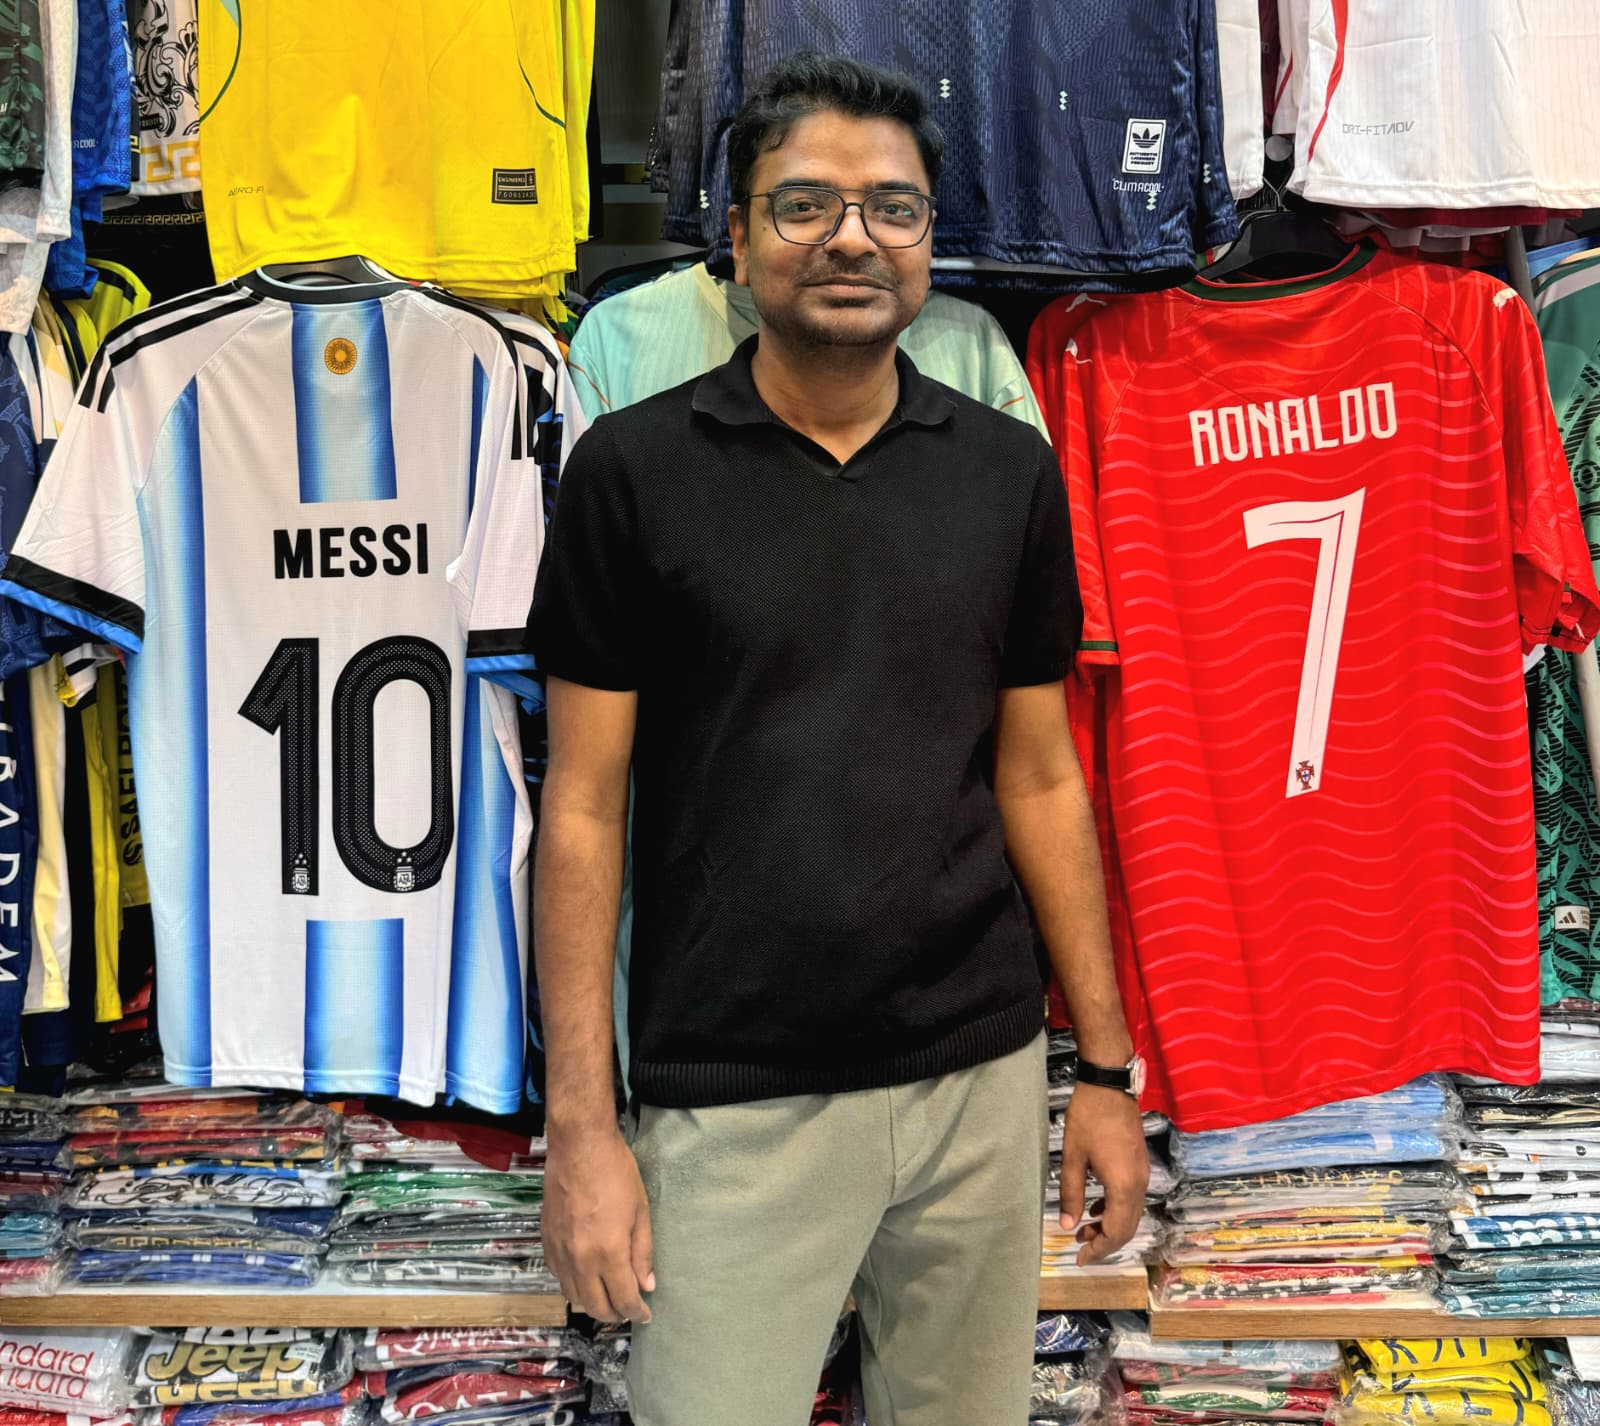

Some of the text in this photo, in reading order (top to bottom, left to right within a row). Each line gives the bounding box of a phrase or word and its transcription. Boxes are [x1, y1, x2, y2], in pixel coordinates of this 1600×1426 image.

[1189, 382, 1398, 467] RONALDO
[273, 523, 429, 579] MESSI
[1243, 487, 1365, 798] 7
[238, 635, 454, 895] 10
[146, 1342, 303, 1382] Jeep
